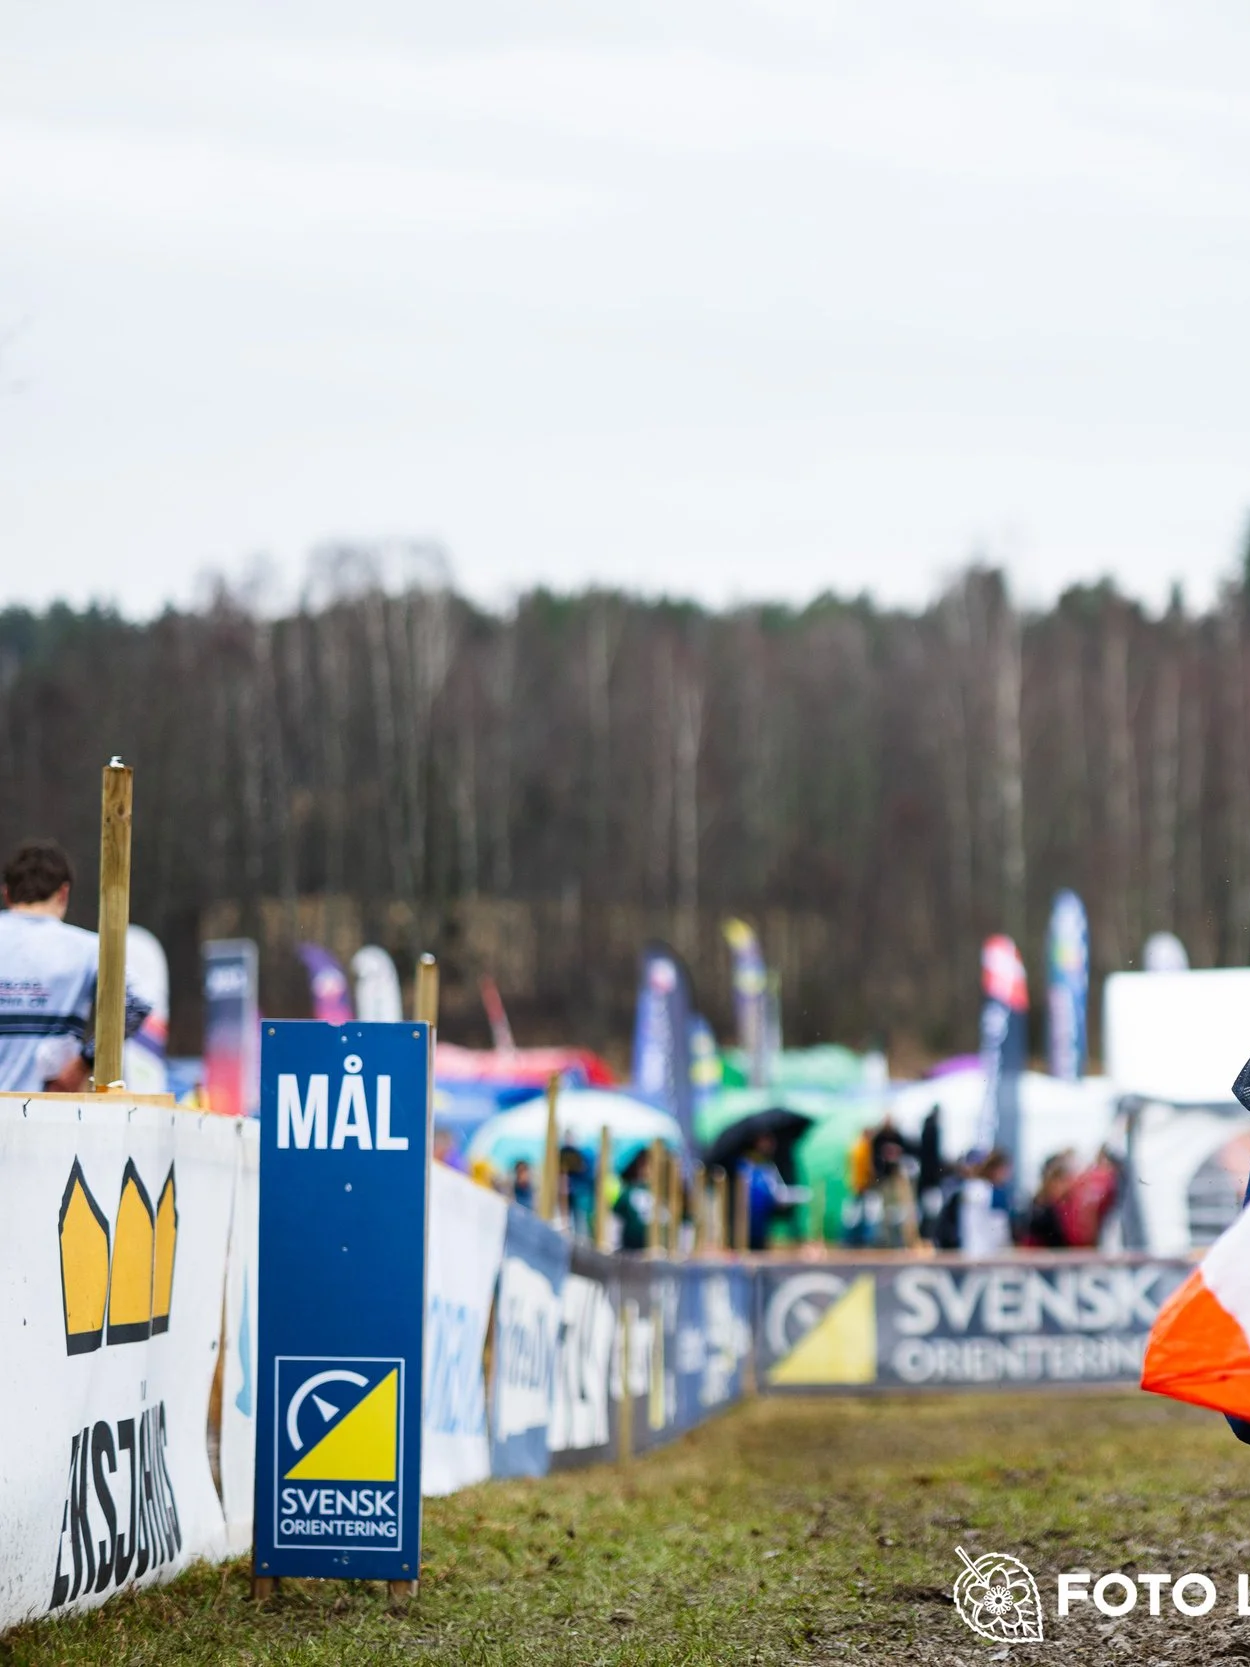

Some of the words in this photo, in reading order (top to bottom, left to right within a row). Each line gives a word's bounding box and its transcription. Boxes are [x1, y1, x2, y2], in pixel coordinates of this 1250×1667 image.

[277, 1054, 409, 1150] MÅL
[894, 1266, 1160, 1336] SVENSK
[894, 1336, 1145, 1382] ORIENTERIN
[281, 1489, 397, 1517] SVENSK
[280, 1518, 397, 1539] ORIENTERING
